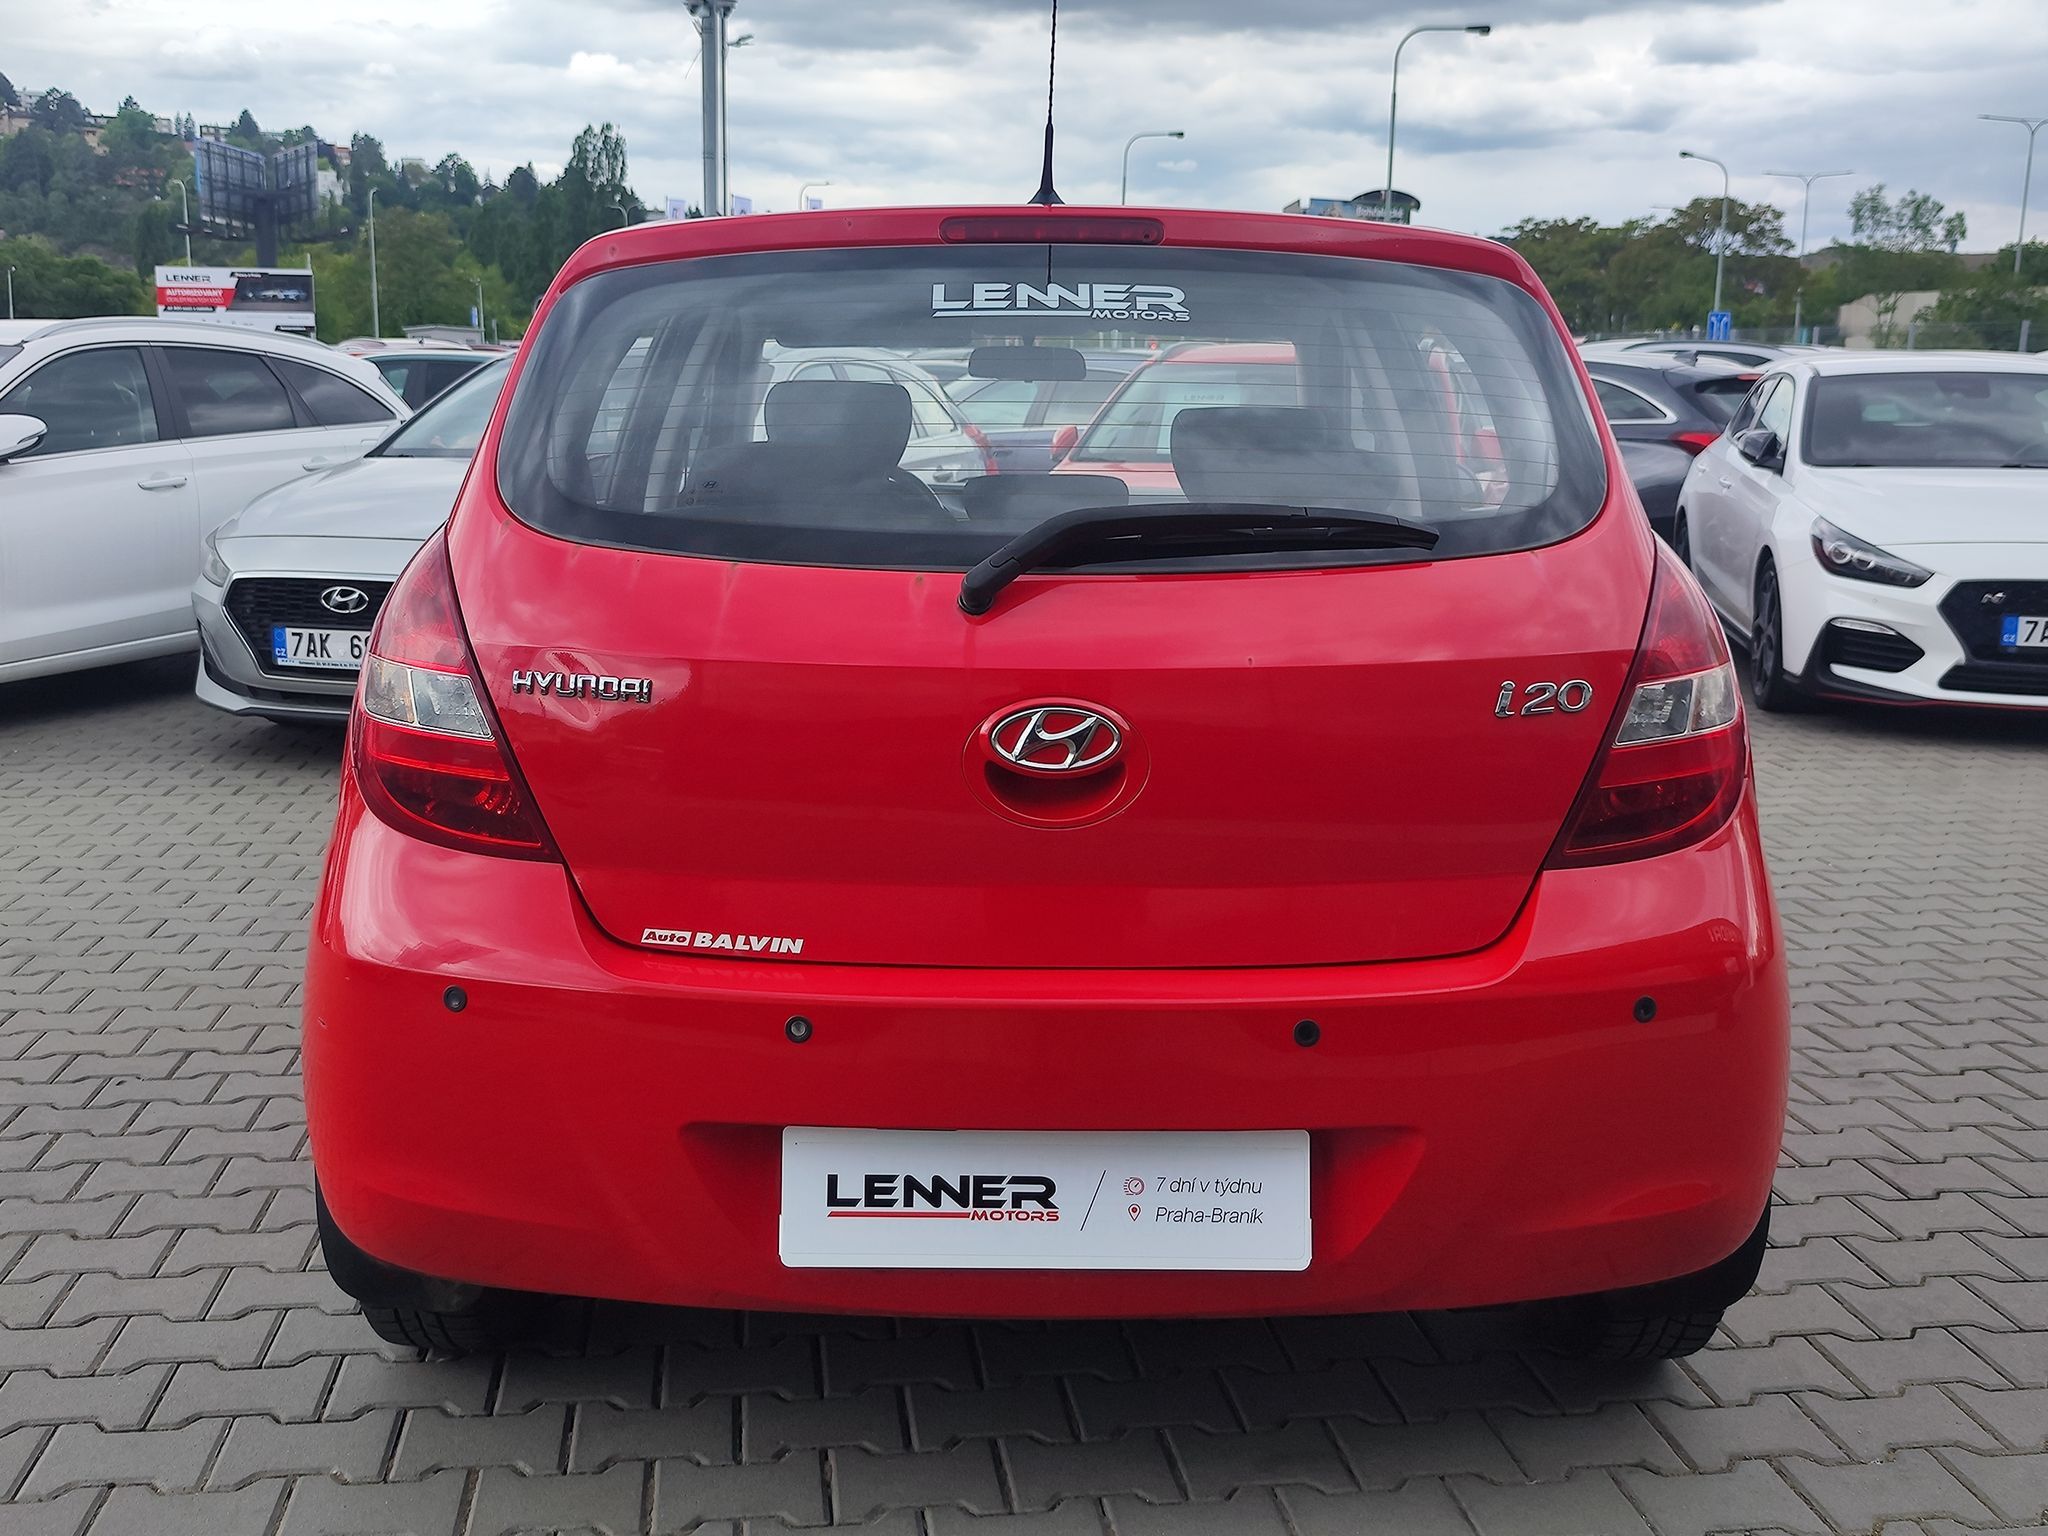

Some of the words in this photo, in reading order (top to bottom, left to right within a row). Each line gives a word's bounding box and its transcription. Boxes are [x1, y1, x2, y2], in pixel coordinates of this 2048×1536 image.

[165, 274, 212, 282] LENNER
[932, 283, 1190, 312] LENNER
[1091, 309, 1191, 321] MOTORS
[275, 647, 287, 656] CZ
[291, 632, 332, 658] 7AK
[350, 634, 371, 659] 6
[512, 669, 653, 702] HYUNDAI
[1495, 680, 1593, 717] i20
[643, 930, 688, 943] Auto
[693, 932, 804, 954] BALVIN
[826, 1173, 1060, 1209] LENNER
[1156, 1177, 1167, 1192] 7
[1169, 1177, 1196, 1193] dní
[1200, 1180, 1211, 1193] v
[1214, 1178, 1263, 1197] týdnu
[970, 1209, 1060, 1221] MOTORS
[1155, 1206, 1264, 1224] Praha-Braník
